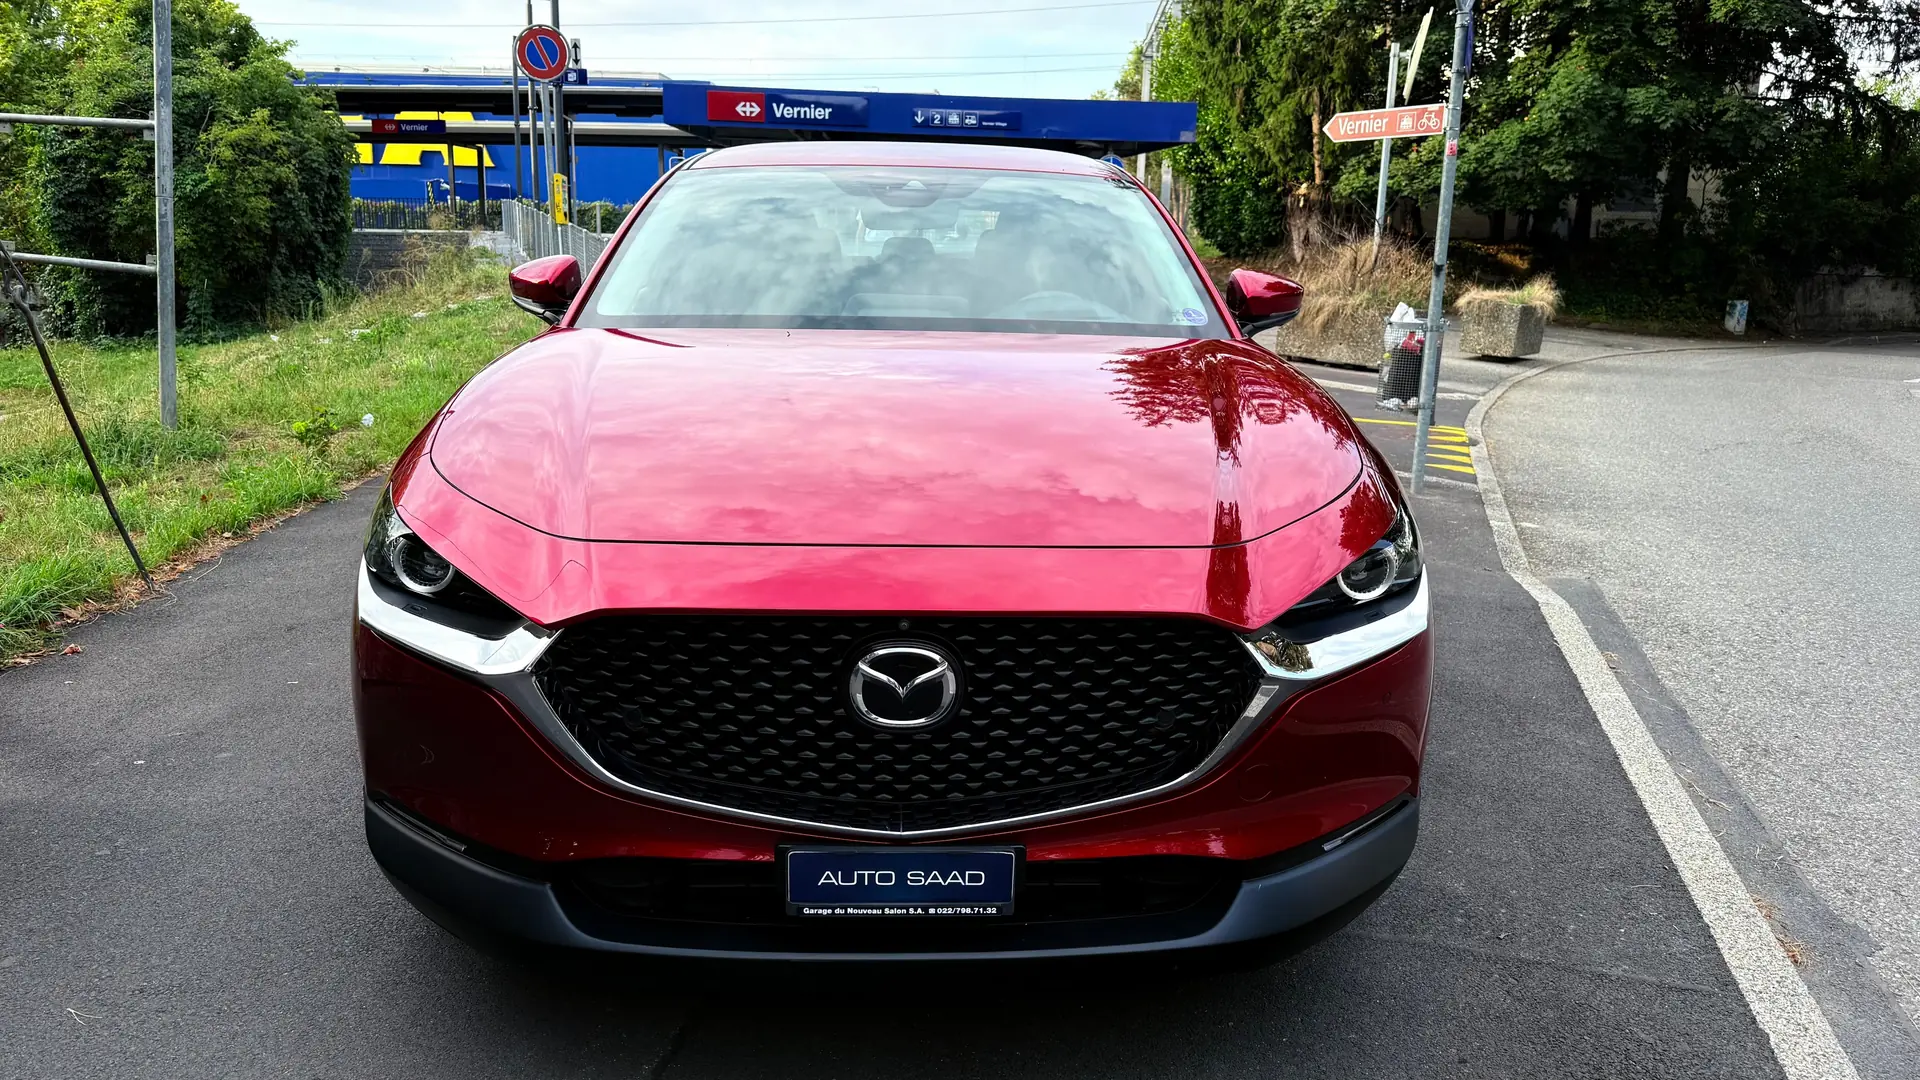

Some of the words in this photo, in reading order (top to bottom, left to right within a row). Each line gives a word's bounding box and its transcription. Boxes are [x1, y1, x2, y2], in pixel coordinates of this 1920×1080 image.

[772, 102, 833, 119] Vernier
[933, 114, 941, 124] 2
[1338, 114, 1389, 135] Vernier
[400, 123, 428, 131] Vernier
[817, 870, 896, 886] AUTO
[906, 870, 986, 886] SAAD
[803, 907, 832, 915] Garage
